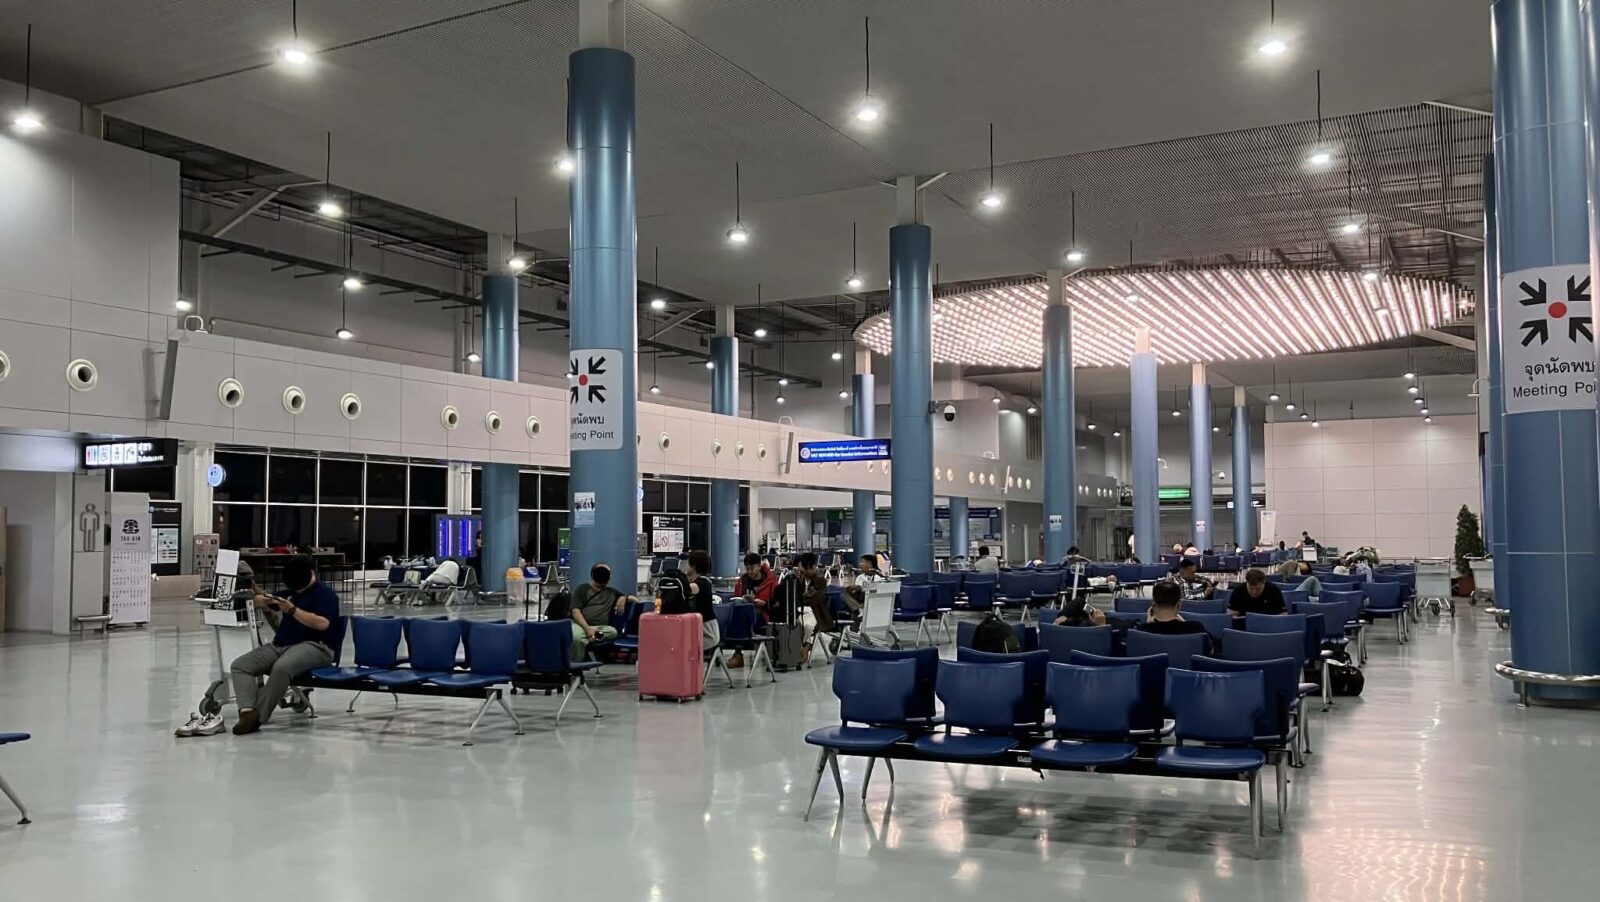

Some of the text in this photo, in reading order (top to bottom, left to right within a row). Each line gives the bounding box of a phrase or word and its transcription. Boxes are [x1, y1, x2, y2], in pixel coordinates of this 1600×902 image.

[1525, 356, 1595, 382] จุดนัดพบ
[1513, 381, 1596, 397] Meeting Poi
[590, 430, 614, 439] Point
